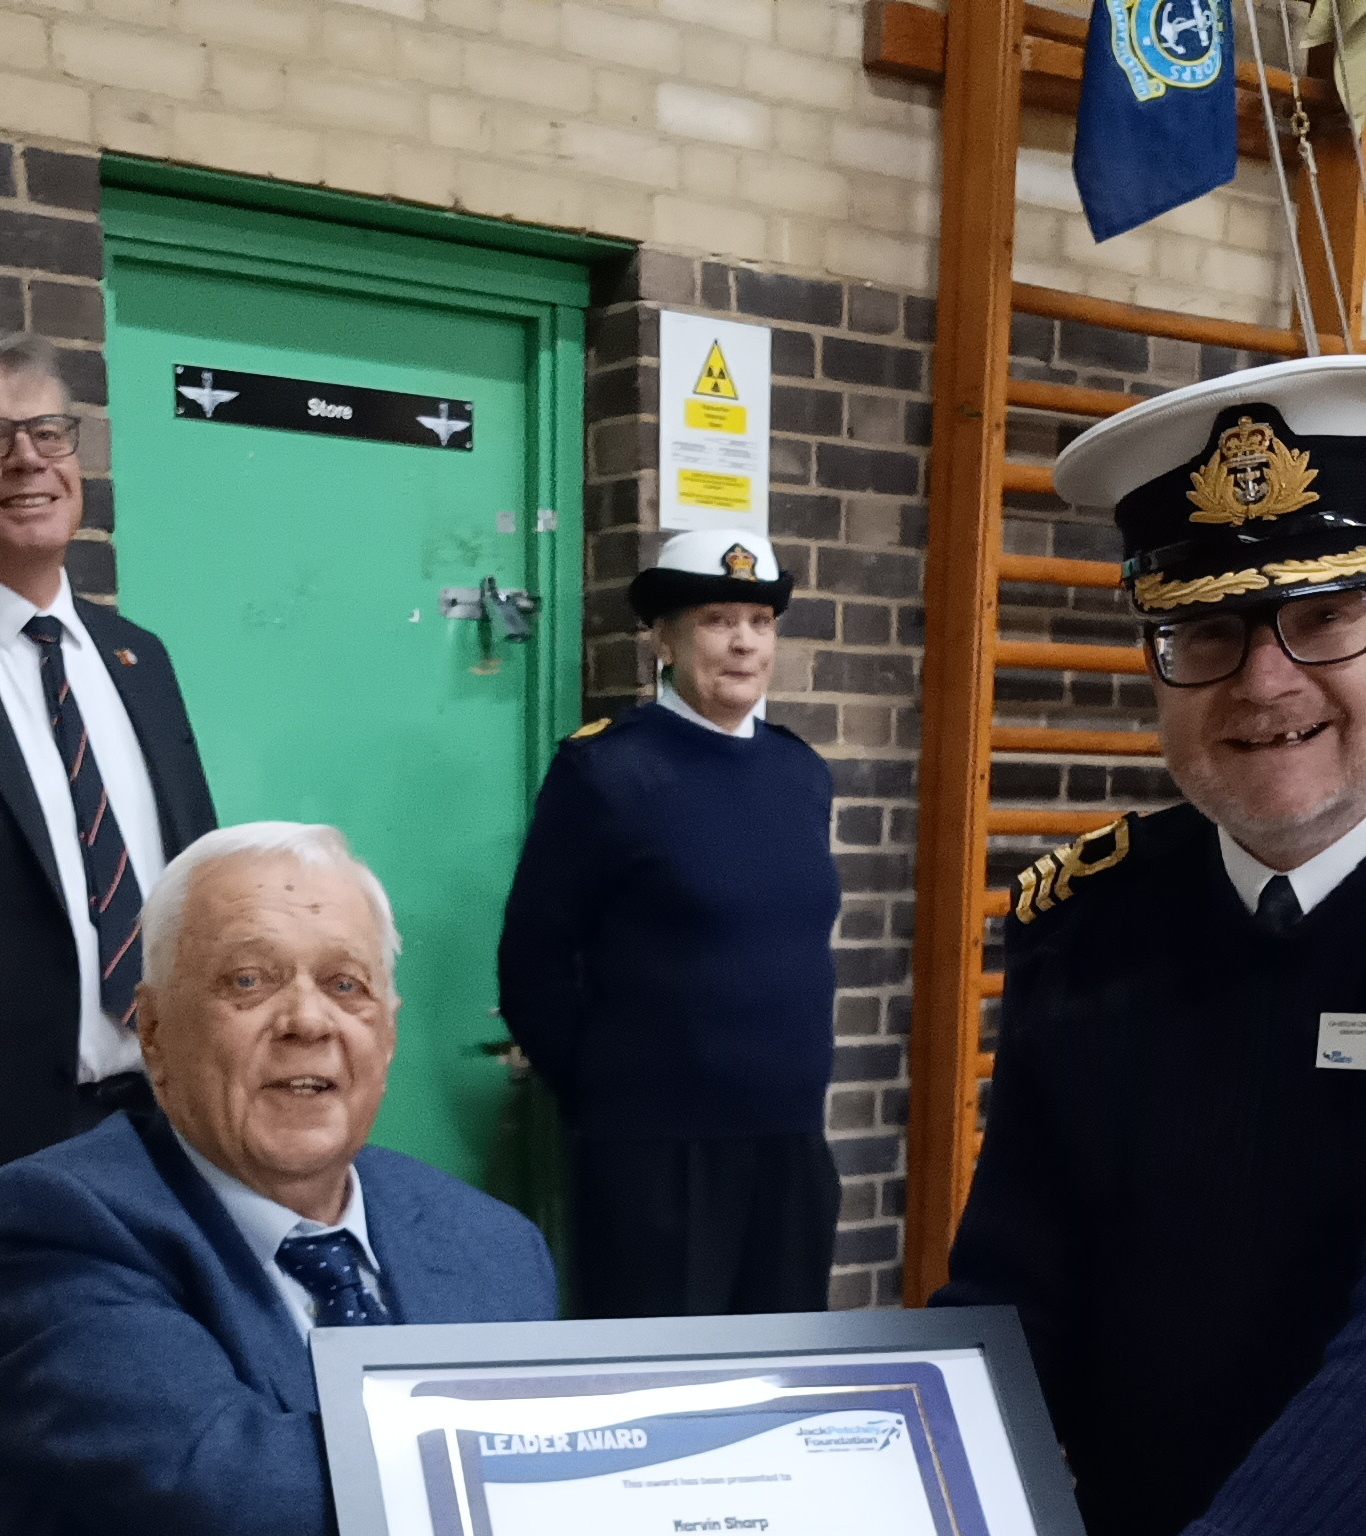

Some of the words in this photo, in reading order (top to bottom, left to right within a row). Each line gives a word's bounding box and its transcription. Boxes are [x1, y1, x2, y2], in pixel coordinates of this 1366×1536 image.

[307, 398, 353, 420] Store
[479, 1433, 572, 1456] LEADER
[577, 1429, 647, 1451] AWARD
[805, 1436, 877, 1446] Foundation
[724, 1516, 768, 1531] Sharp
